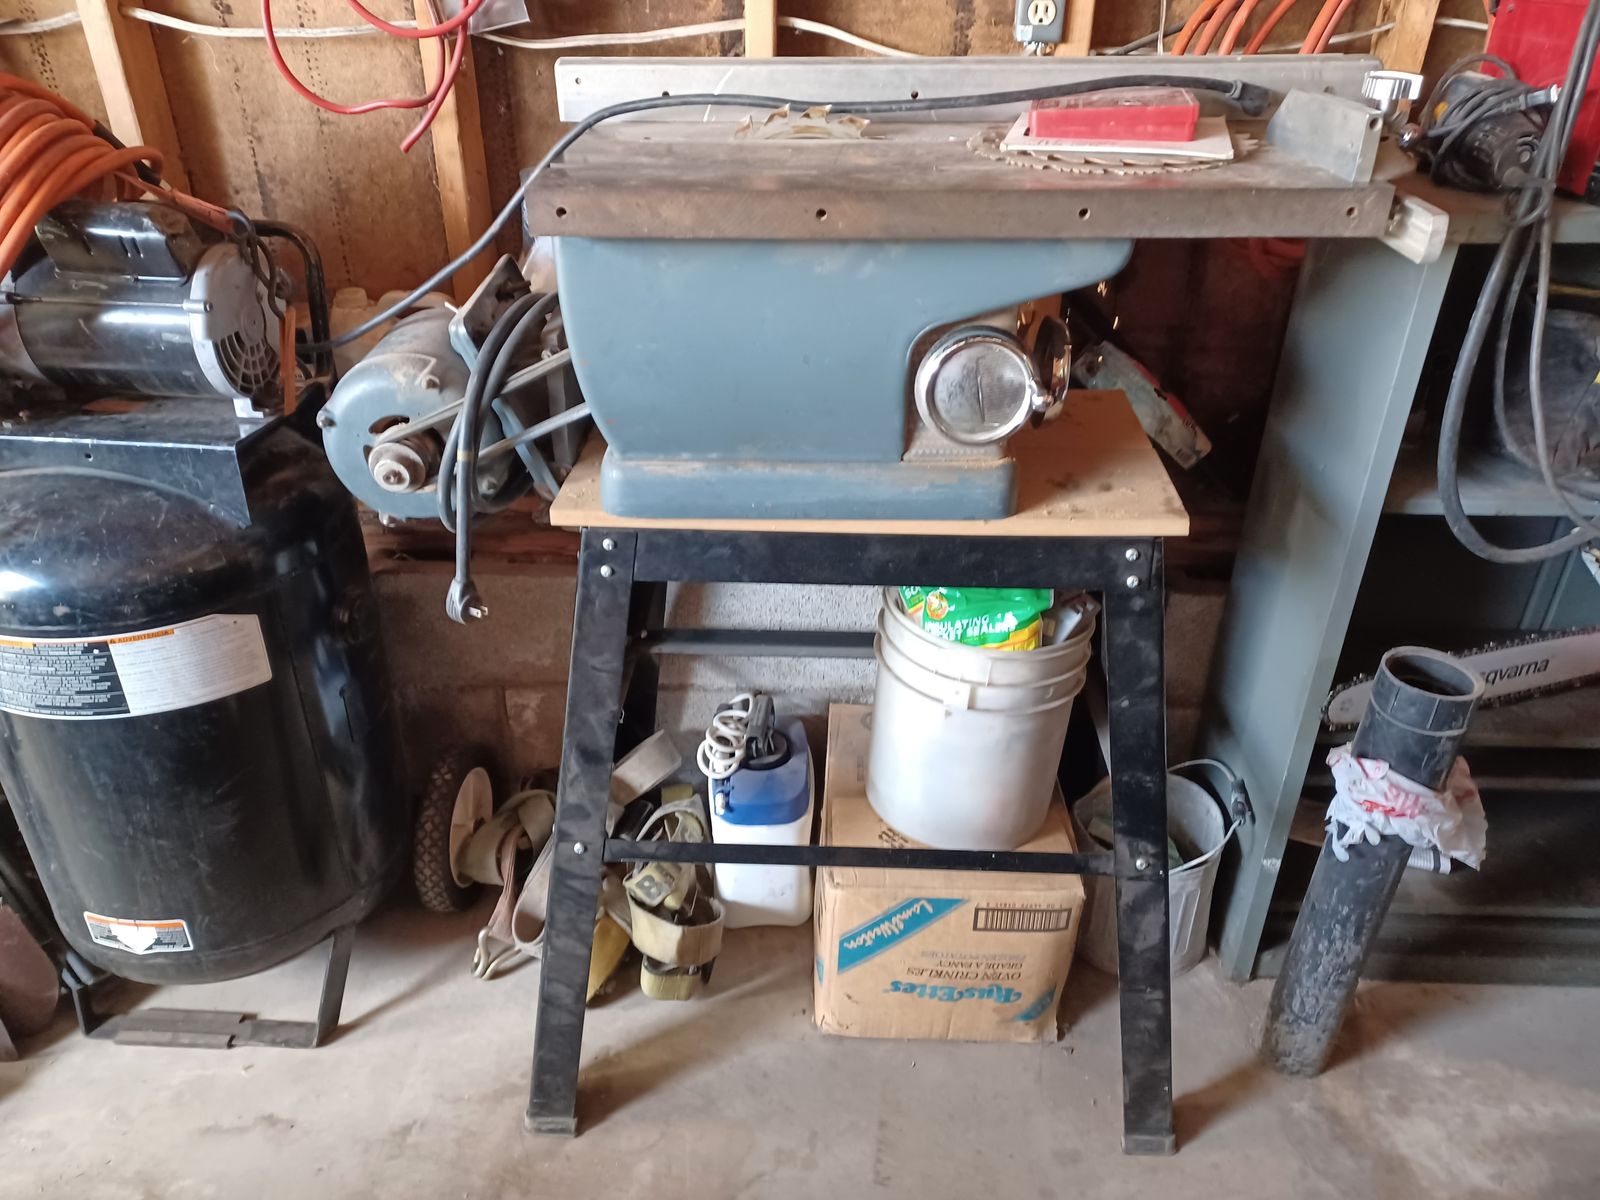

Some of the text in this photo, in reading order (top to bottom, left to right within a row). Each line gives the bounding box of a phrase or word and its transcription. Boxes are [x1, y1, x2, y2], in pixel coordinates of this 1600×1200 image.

[1480, 658, 1550, 686] qvarna
[906, 966, 1022, 981] OVEN CRINKLES
[935, 959, 1023, 971] GRADE A FANCY
[889, 980, 1023, 1005] RusEttes
